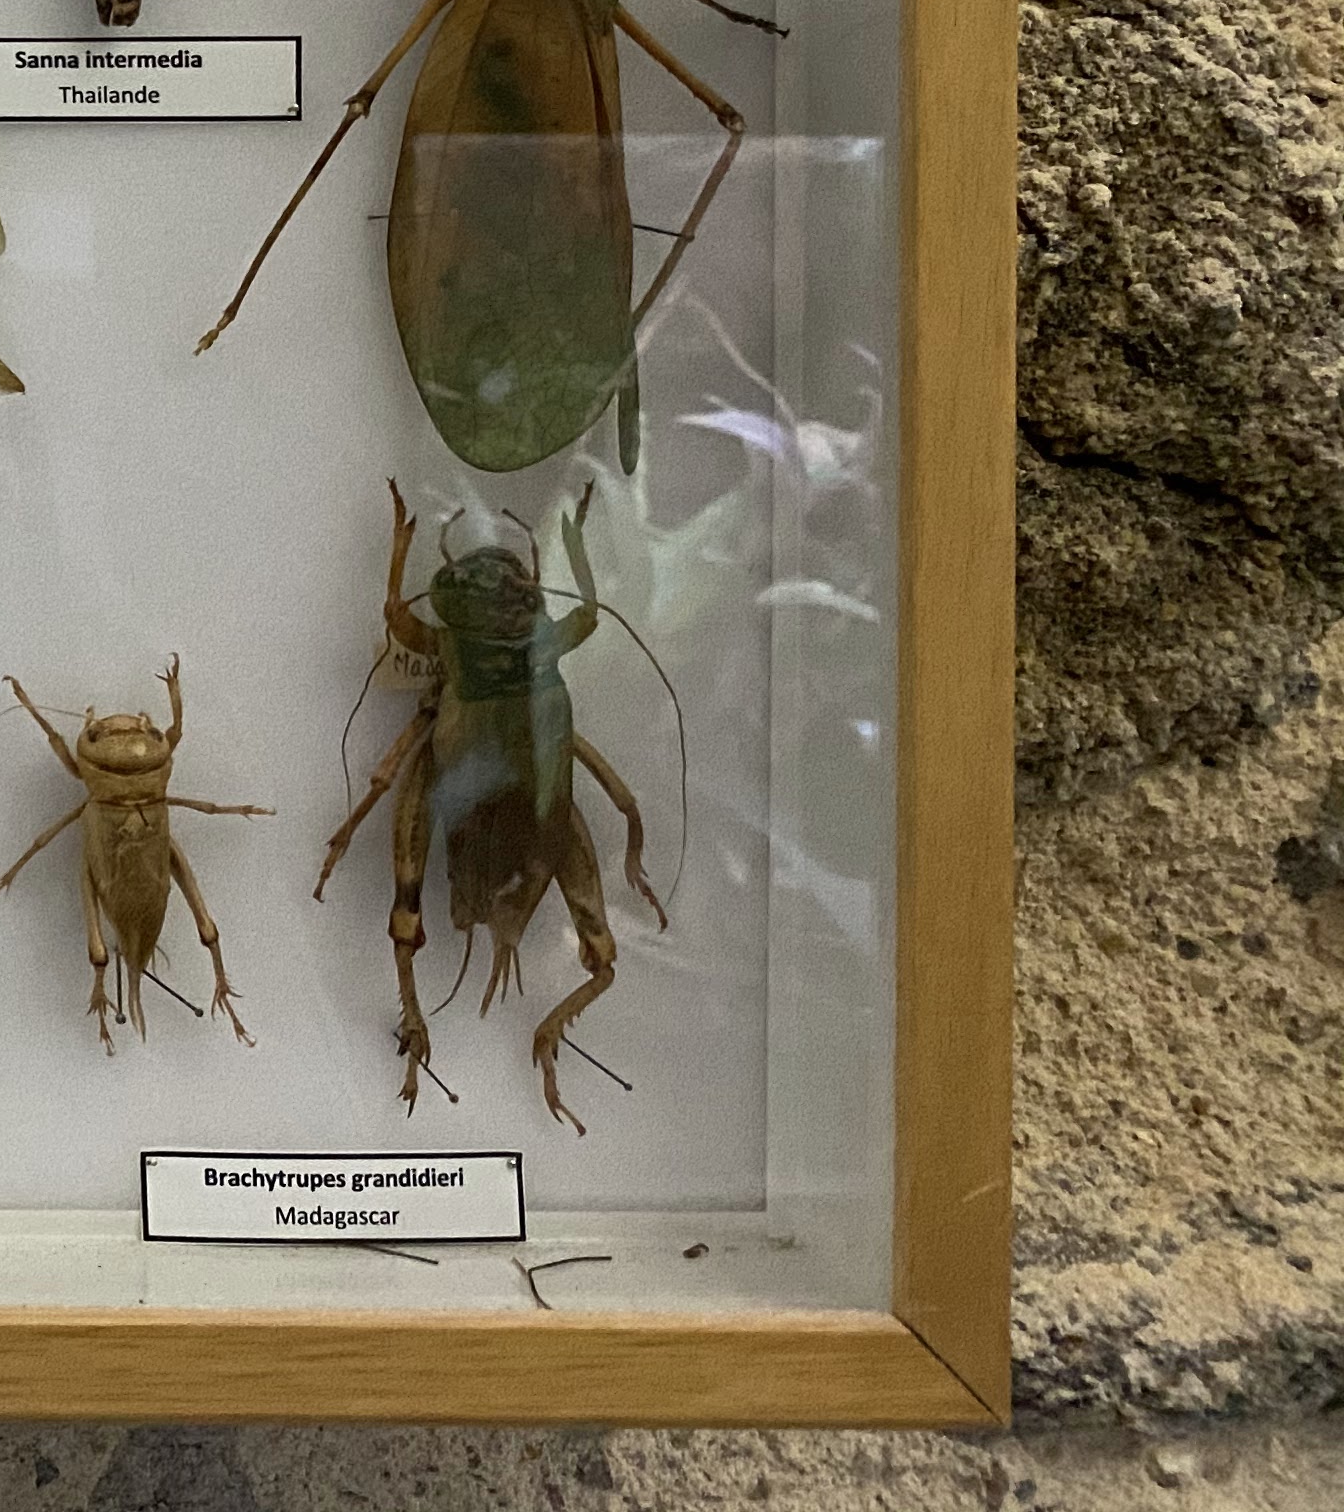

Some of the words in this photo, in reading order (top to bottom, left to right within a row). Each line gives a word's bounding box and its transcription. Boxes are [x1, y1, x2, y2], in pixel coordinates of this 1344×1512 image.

[14, 51, 79, 68] Sanna
[86, 50, 202, 68] intermedia
[59, 86, 160, 104] Thailande
[204, 1168, 345, 1191] Brachytrupes
[352, 1168, 464, 1191] grandidieri
[275, 1205, 399, 1229] Madagascar
